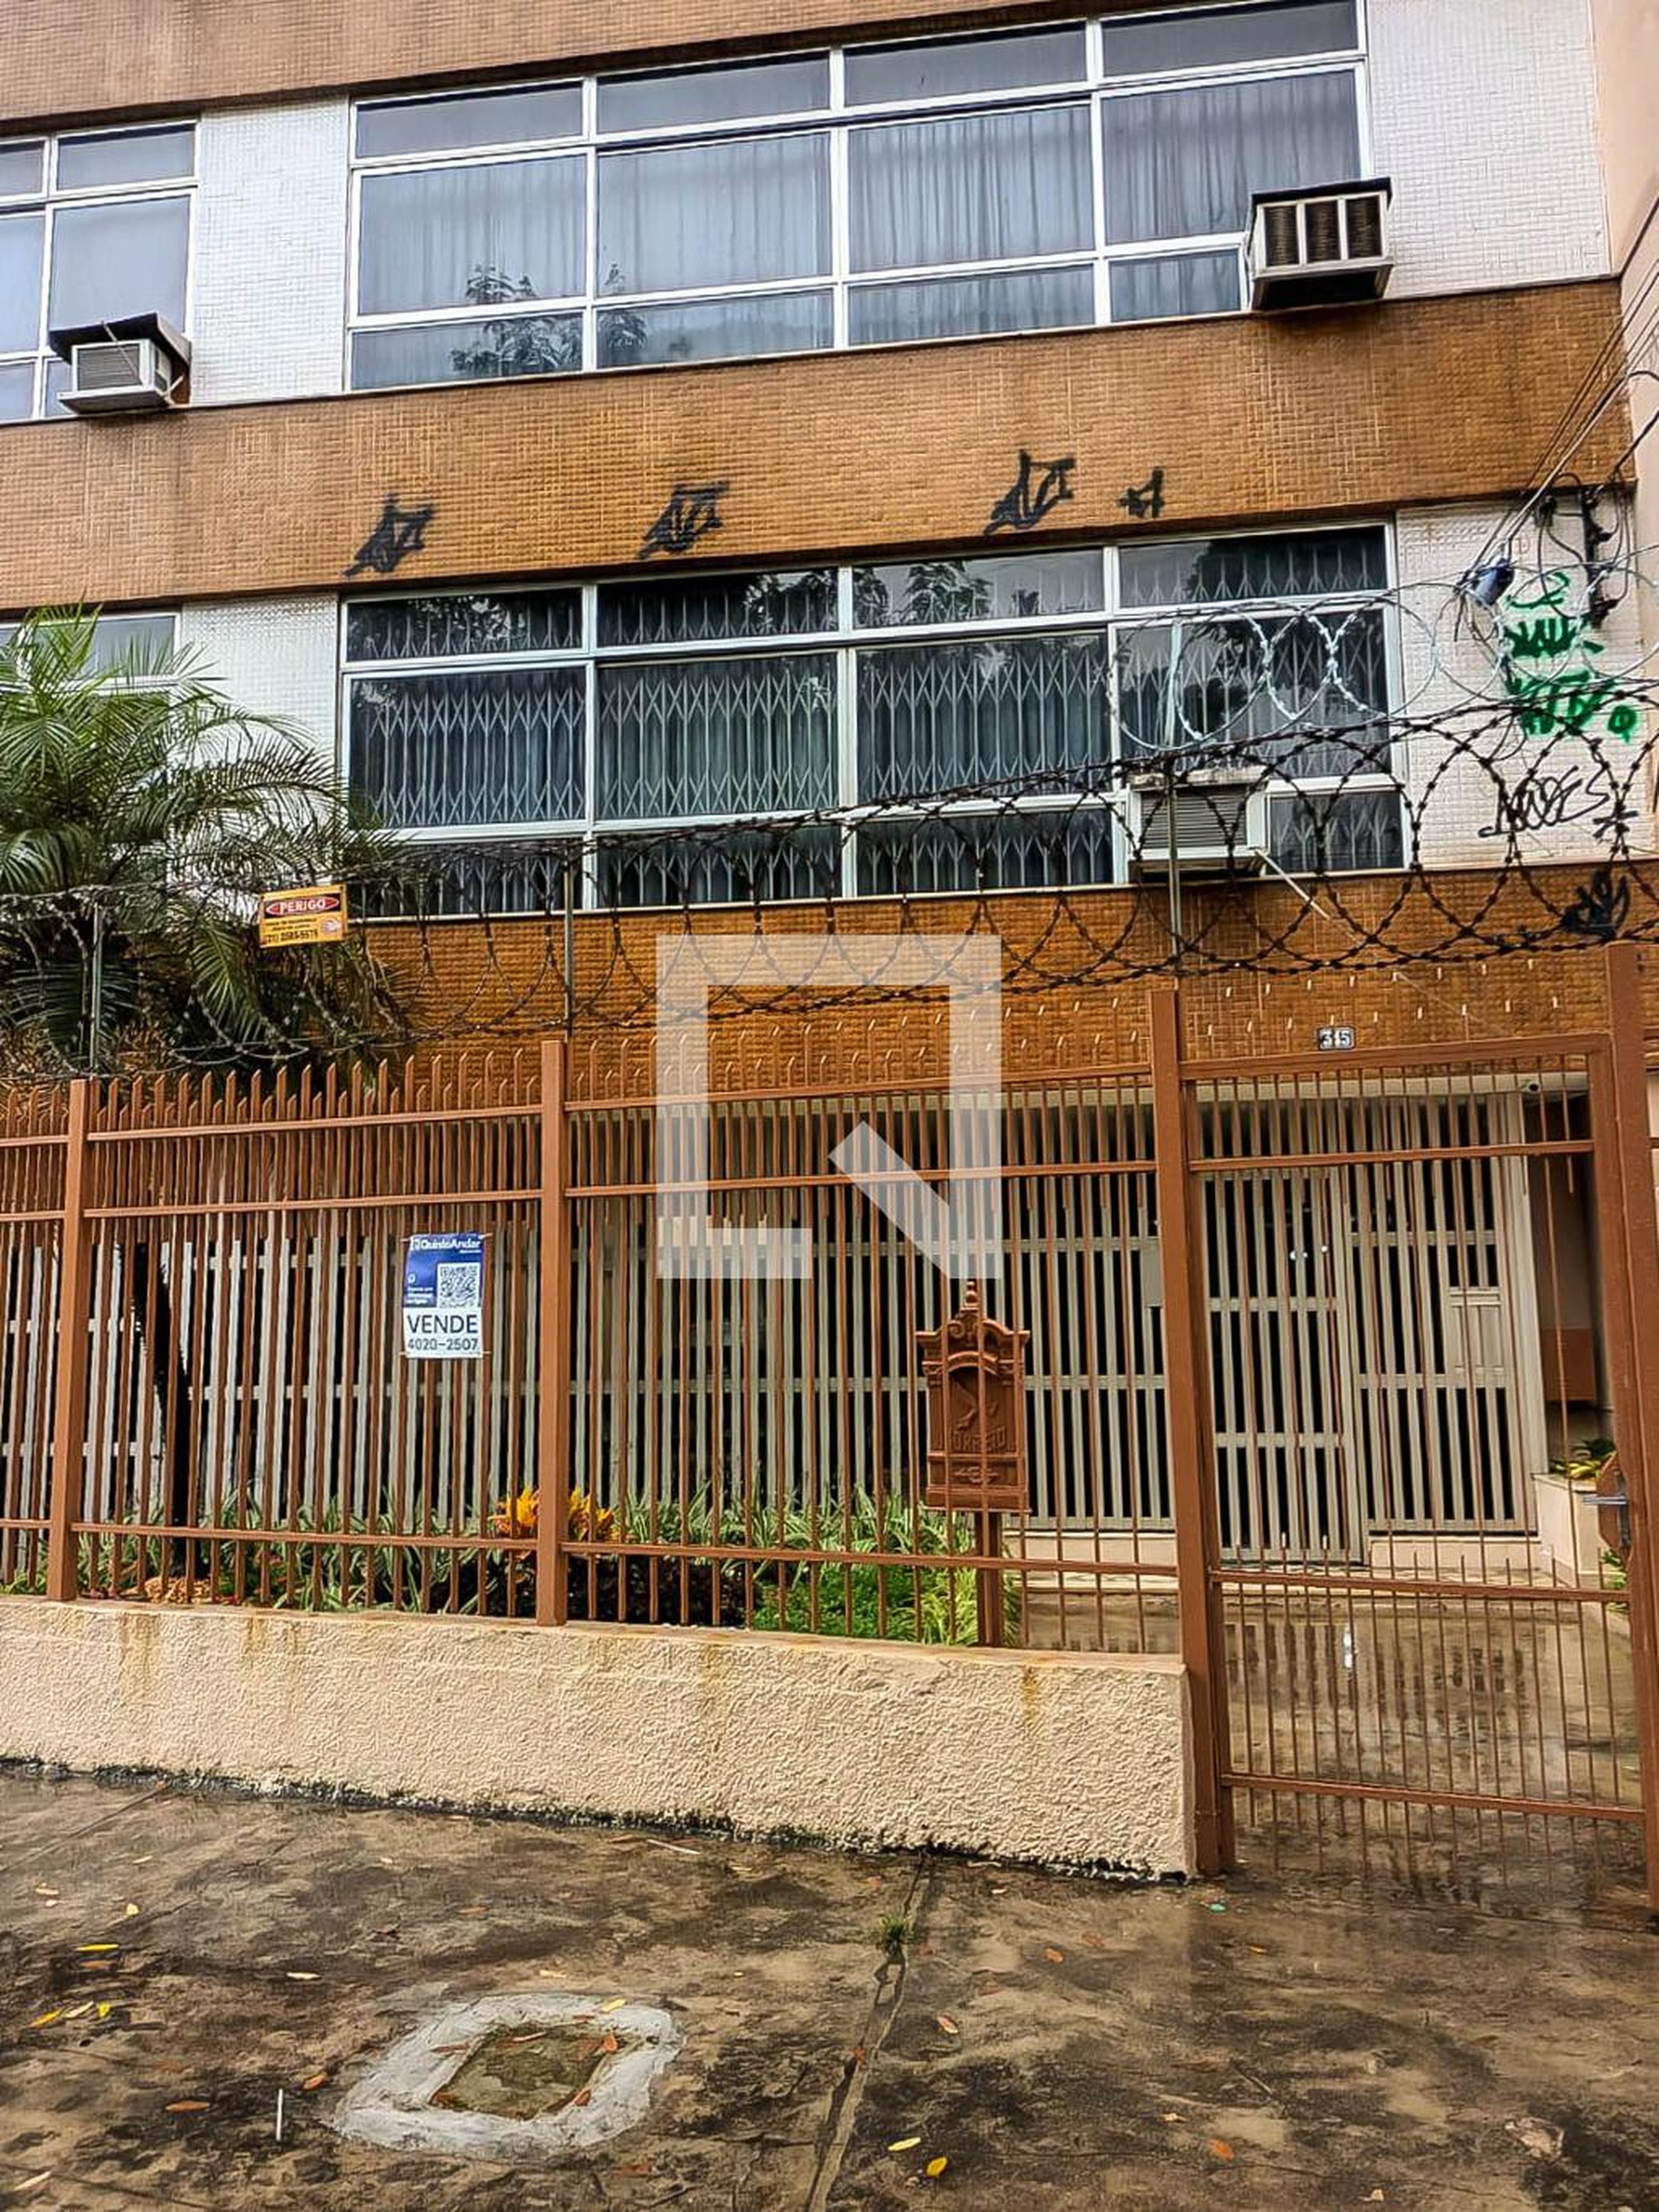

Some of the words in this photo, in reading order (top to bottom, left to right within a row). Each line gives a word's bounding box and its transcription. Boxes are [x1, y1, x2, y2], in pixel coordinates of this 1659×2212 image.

[280, 898, 325, 915] PERIGO
[407, 1314, 478, 1334] VENDE
[408, 1338, 478, 1350] 4020-2507
